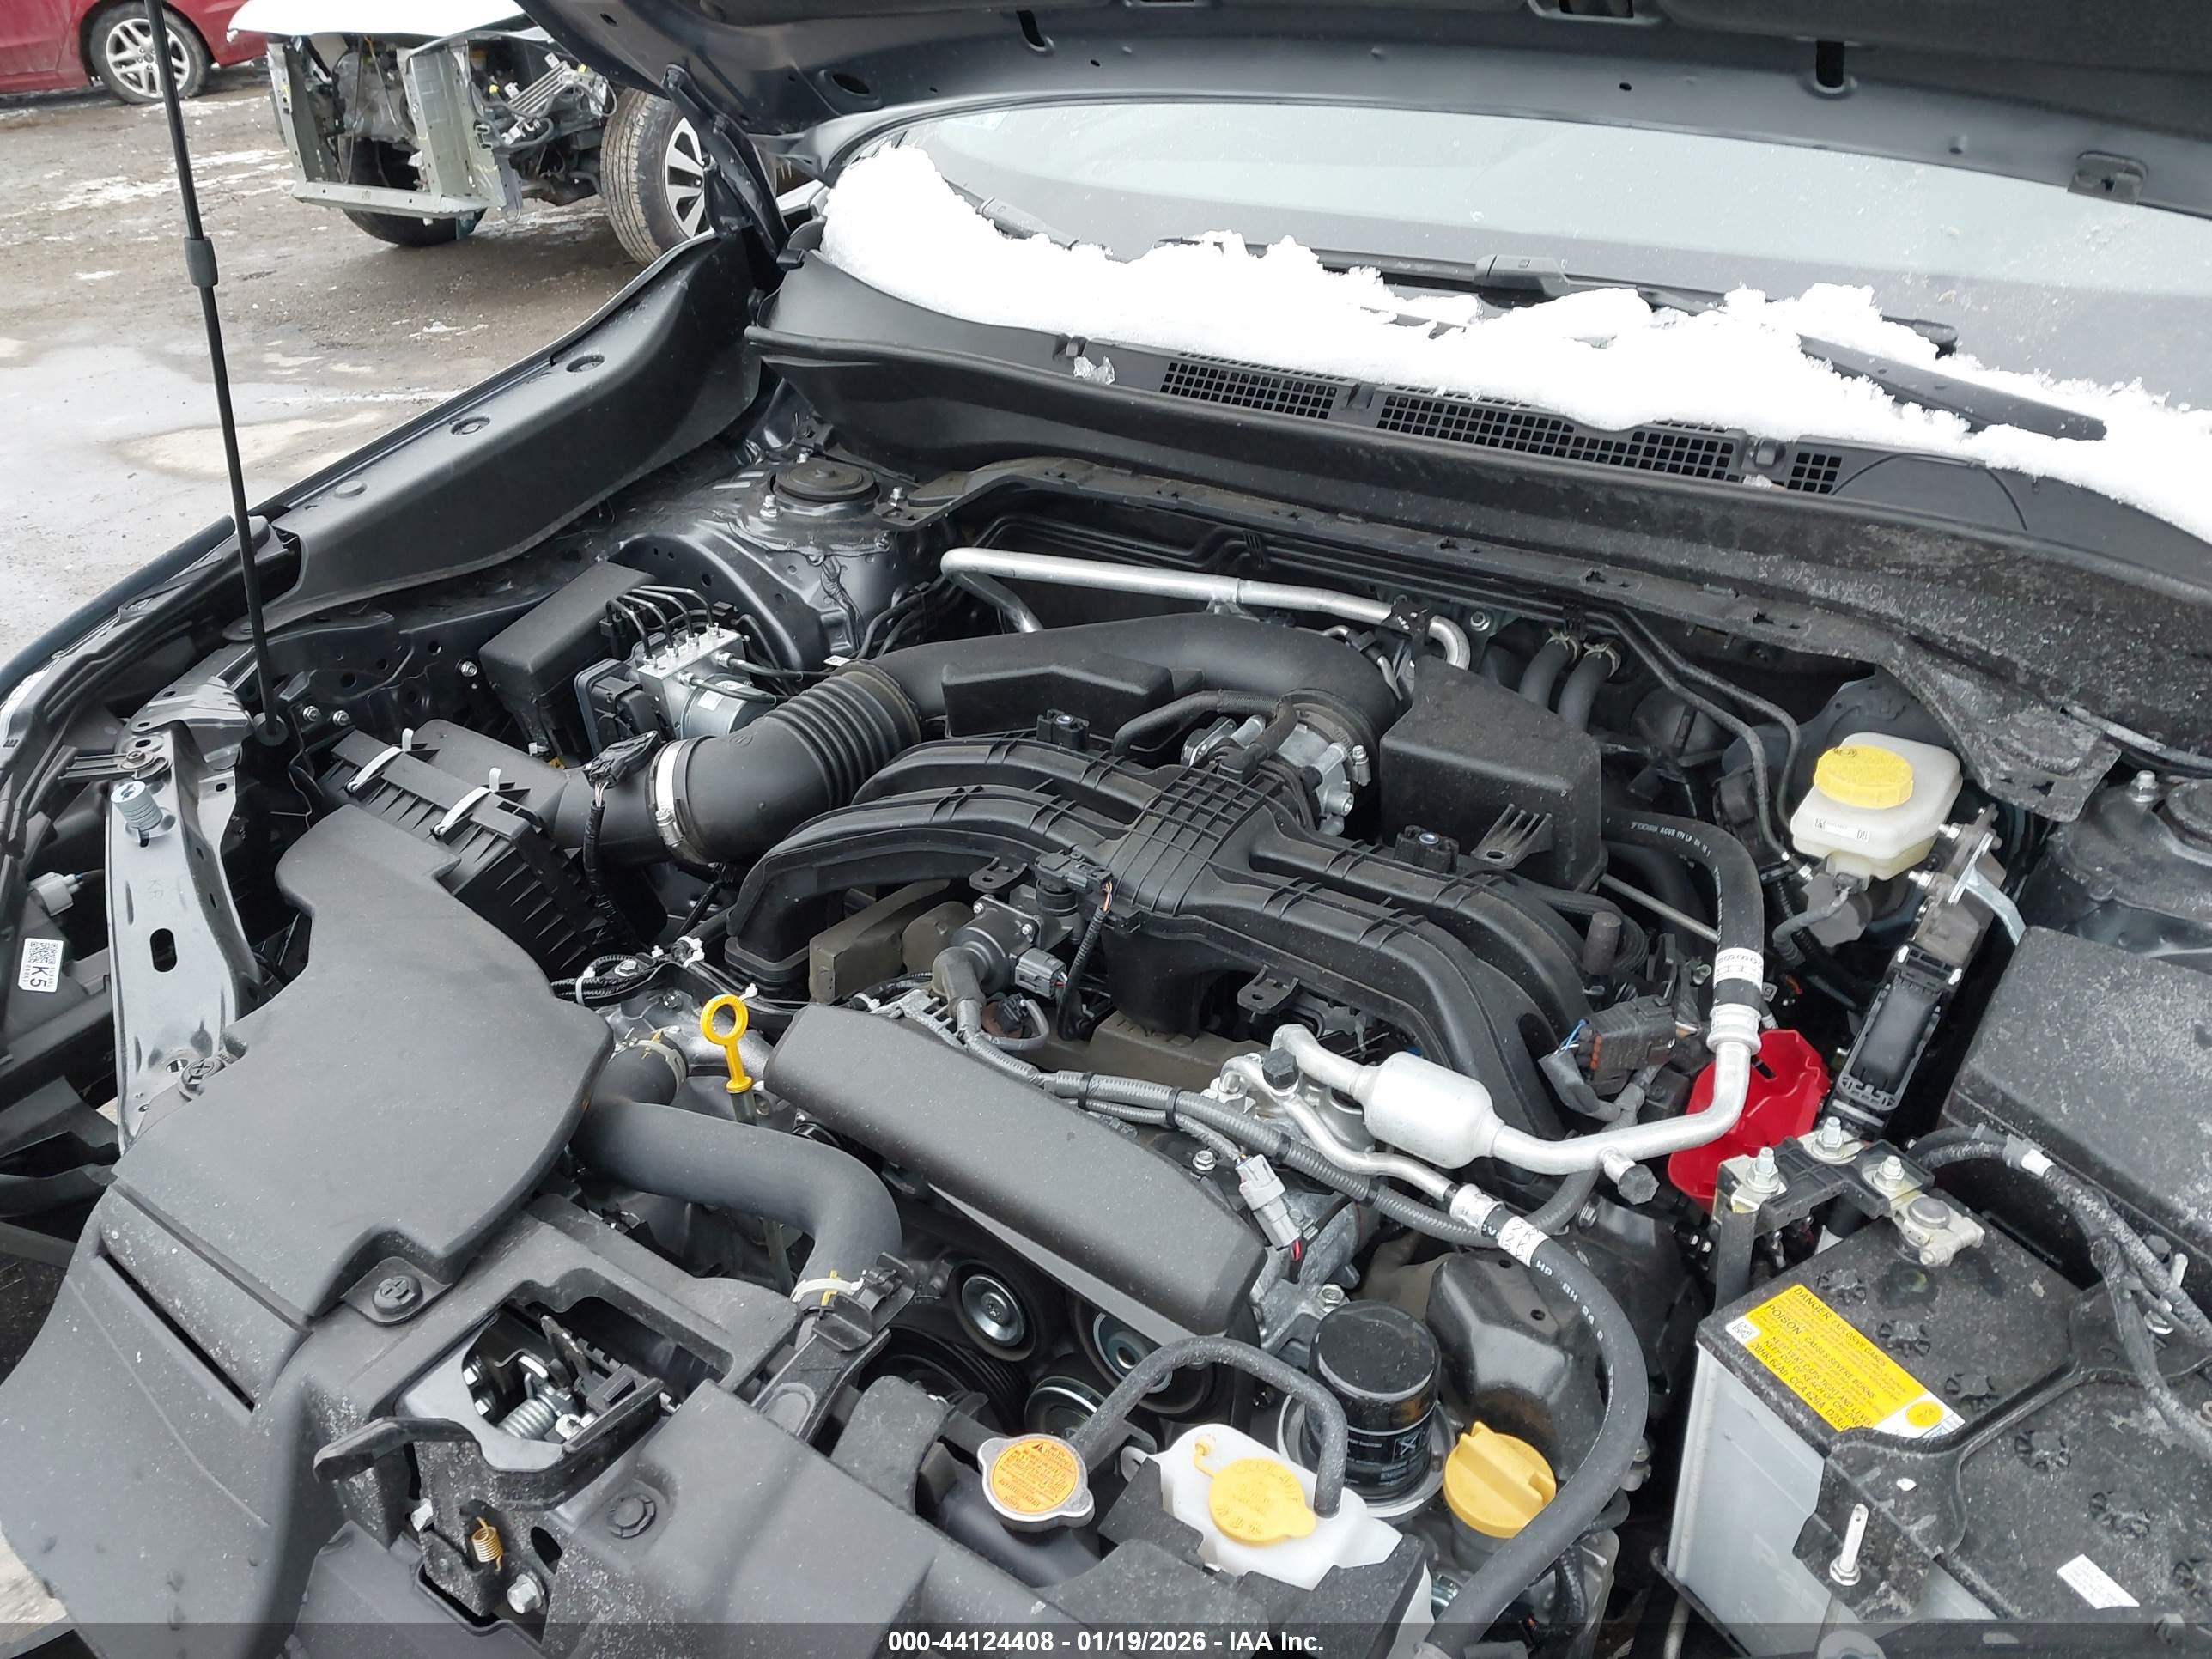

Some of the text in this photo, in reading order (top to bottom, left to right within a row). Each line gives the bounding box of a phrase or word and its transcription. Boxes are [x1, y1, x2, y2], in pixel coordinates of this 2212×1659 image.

[30, 966, 49, 988] K5
[1766, 1304, 1802, 1334] POISON
[1804, 1337, 1829, 1358] CAUSES
[1828, 1358, 1854, 1379] SEVERE
[1853, 1379, 1875, 1398] BURNS
[1794, 1288, 1832, 1319] DANGER
[1832, 1319, 1866, 1348] EXPLOSIVE
[1865, 1347, 1887, 1366] GASES
[1751, 1342, 1771, 1359] 20HR
[1790, 1376, 1806, 1391] CCA
[1805, 1390, 1826, 1408] 620A
[1764, 1340, 1781, 1355] KEEP
[1780, 1354, 1793, 1365] OUT
[1802, 1373, 1824, 1393] REACH
[1839, 1395, 1853, 1408] AND
